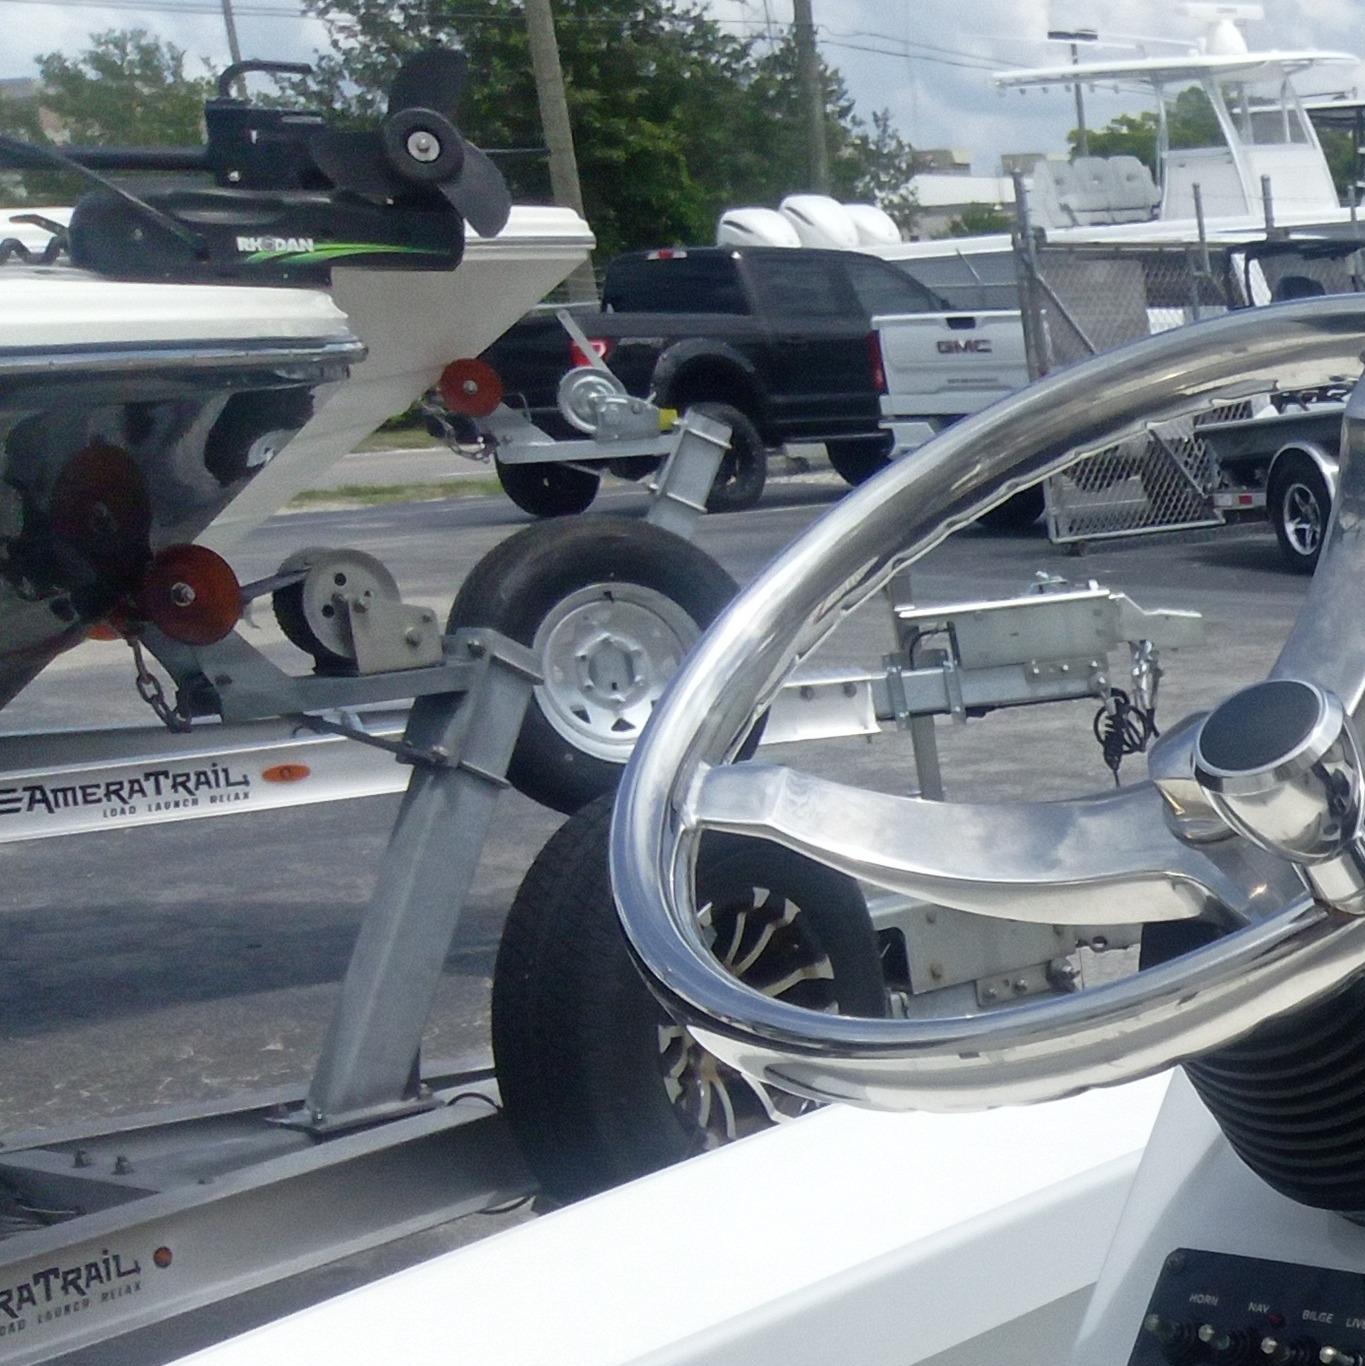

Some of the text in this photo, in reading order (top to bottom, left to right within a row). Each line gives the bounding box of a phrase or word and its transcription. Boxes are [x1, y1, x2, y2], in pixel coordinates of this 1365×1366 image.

[937, 340, 992, 353] GMC
[1189, 1292, 1219, 1306] HORN
[1248, 1302, 1271, 1314] NAV
[1302, 1308, 1334, 1325] BILGE
